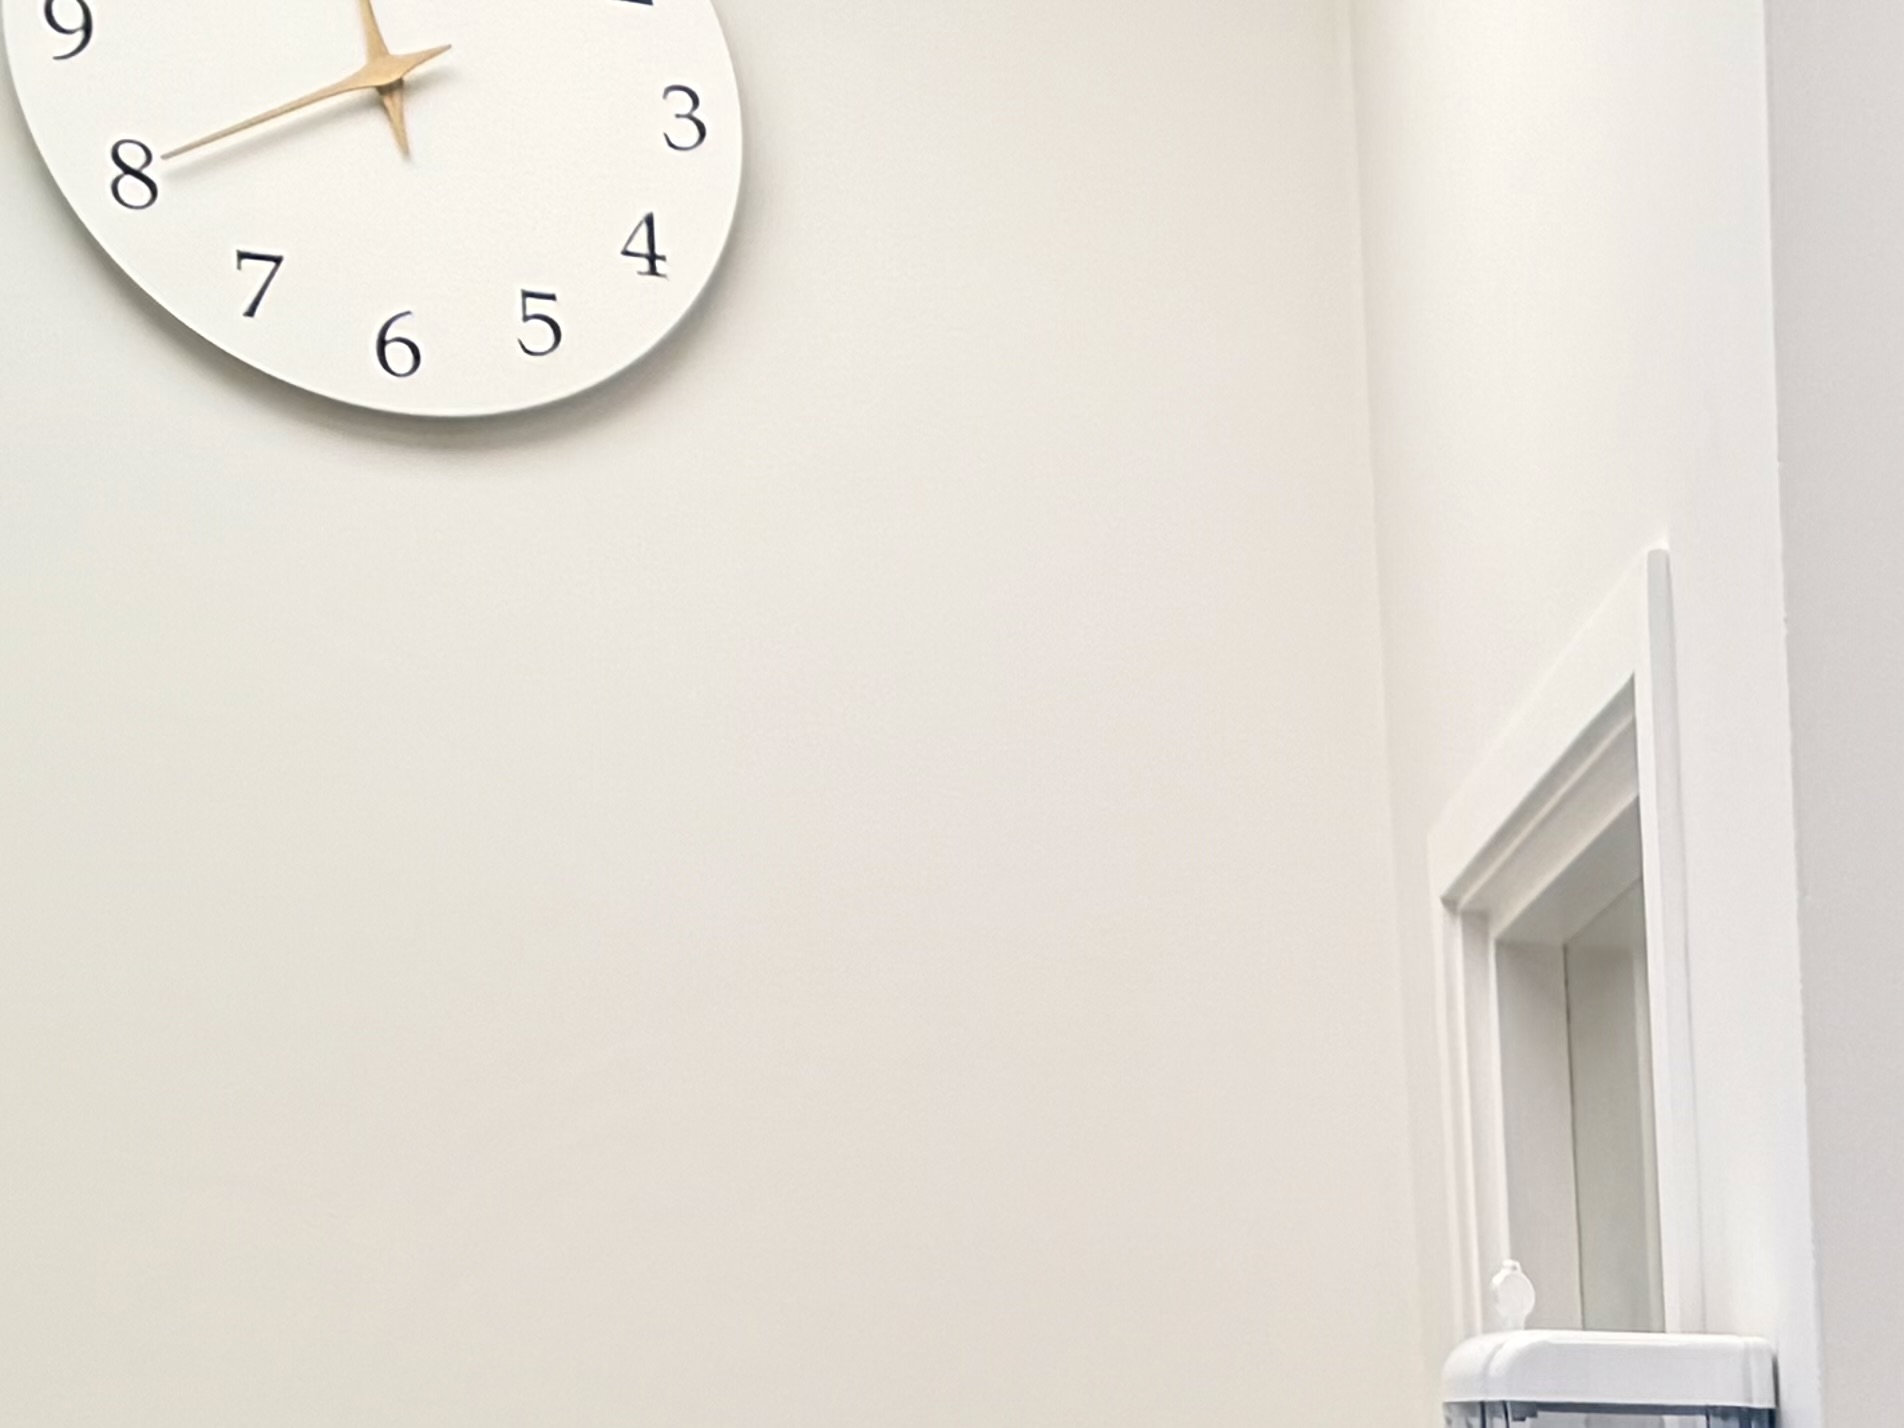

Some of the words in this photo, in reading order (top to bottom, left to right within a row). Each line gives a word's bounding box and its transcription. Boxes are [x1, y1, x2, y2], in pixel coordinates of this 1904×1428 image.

[44, 0, 93, 61] 9
[662, 84, 708, 152] 3
[110, 138, 159, 210] 8
[620, 211, 668, 279] 4
[235, 249, 284, 318] 7
[375, 310, 422, 377] 6
[517, 288, 562, 357] 5
